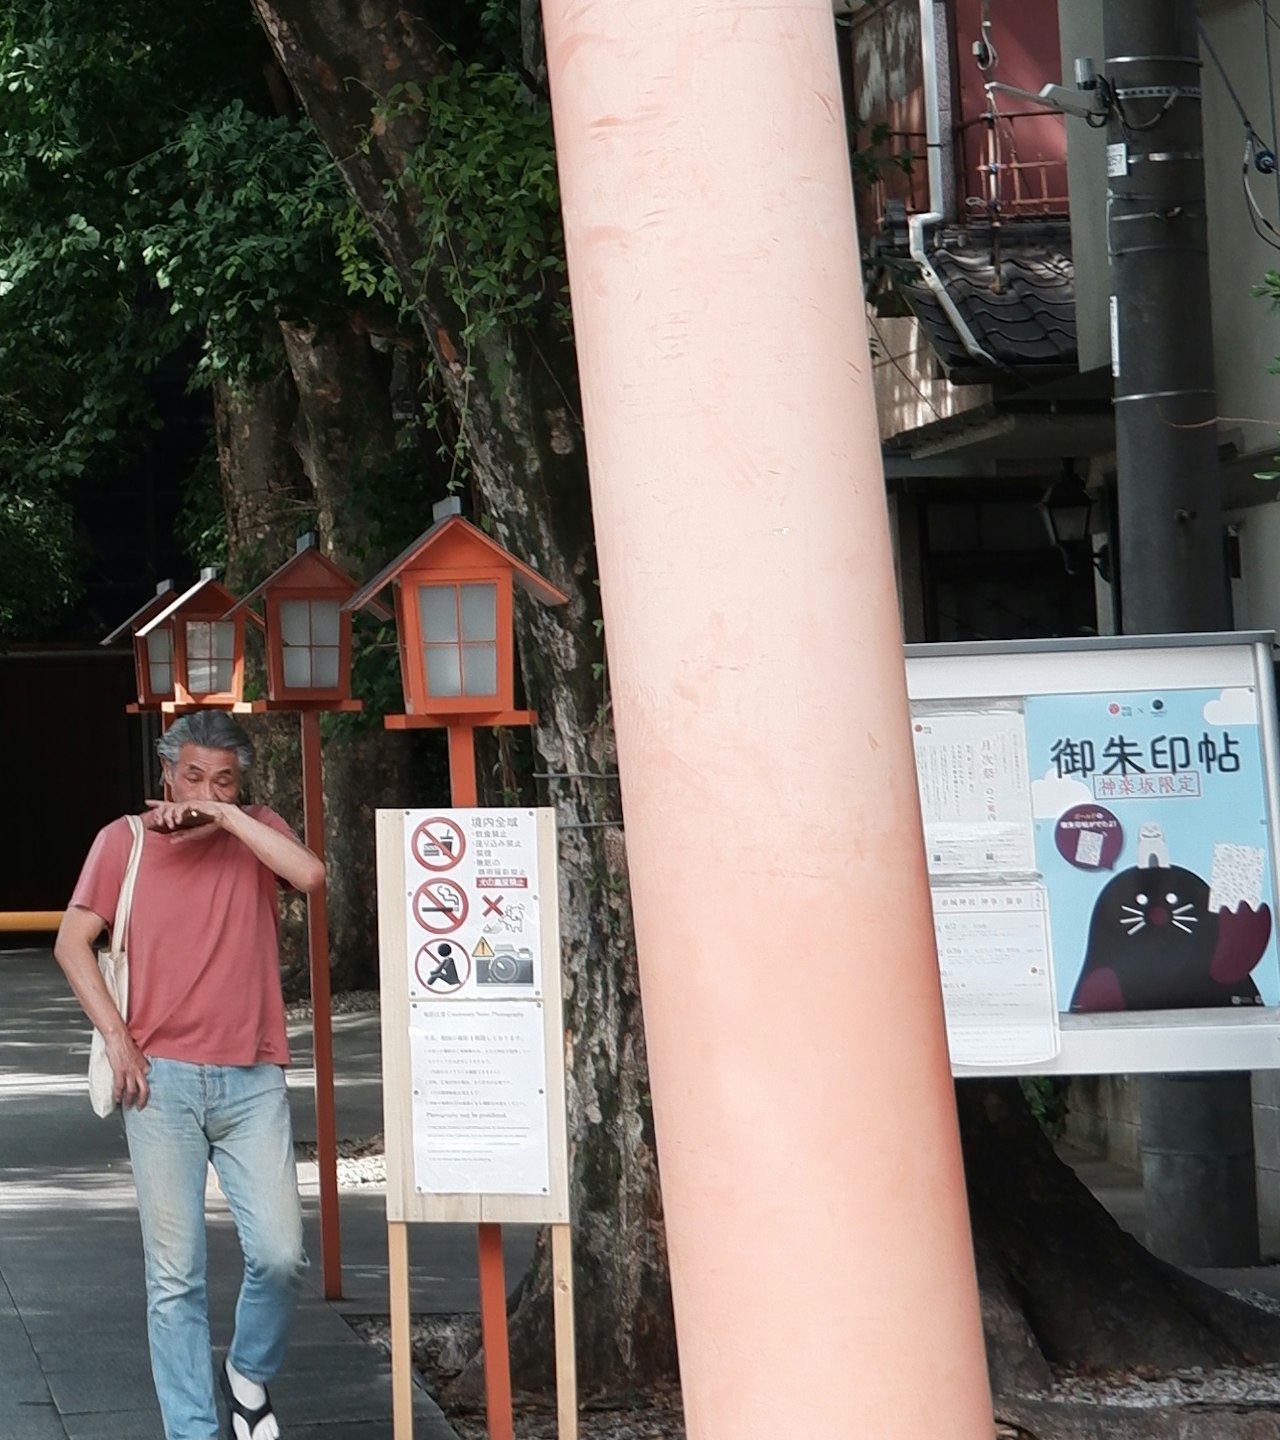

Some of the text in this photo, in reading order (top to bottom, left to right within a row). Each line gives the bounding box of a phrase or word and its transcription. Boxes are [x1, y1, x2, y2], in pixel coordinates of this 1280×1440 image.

[1050, 731, 1240, 779] 御朱印帖
[1100, 776, 1195, 795] 神楽坂限定
